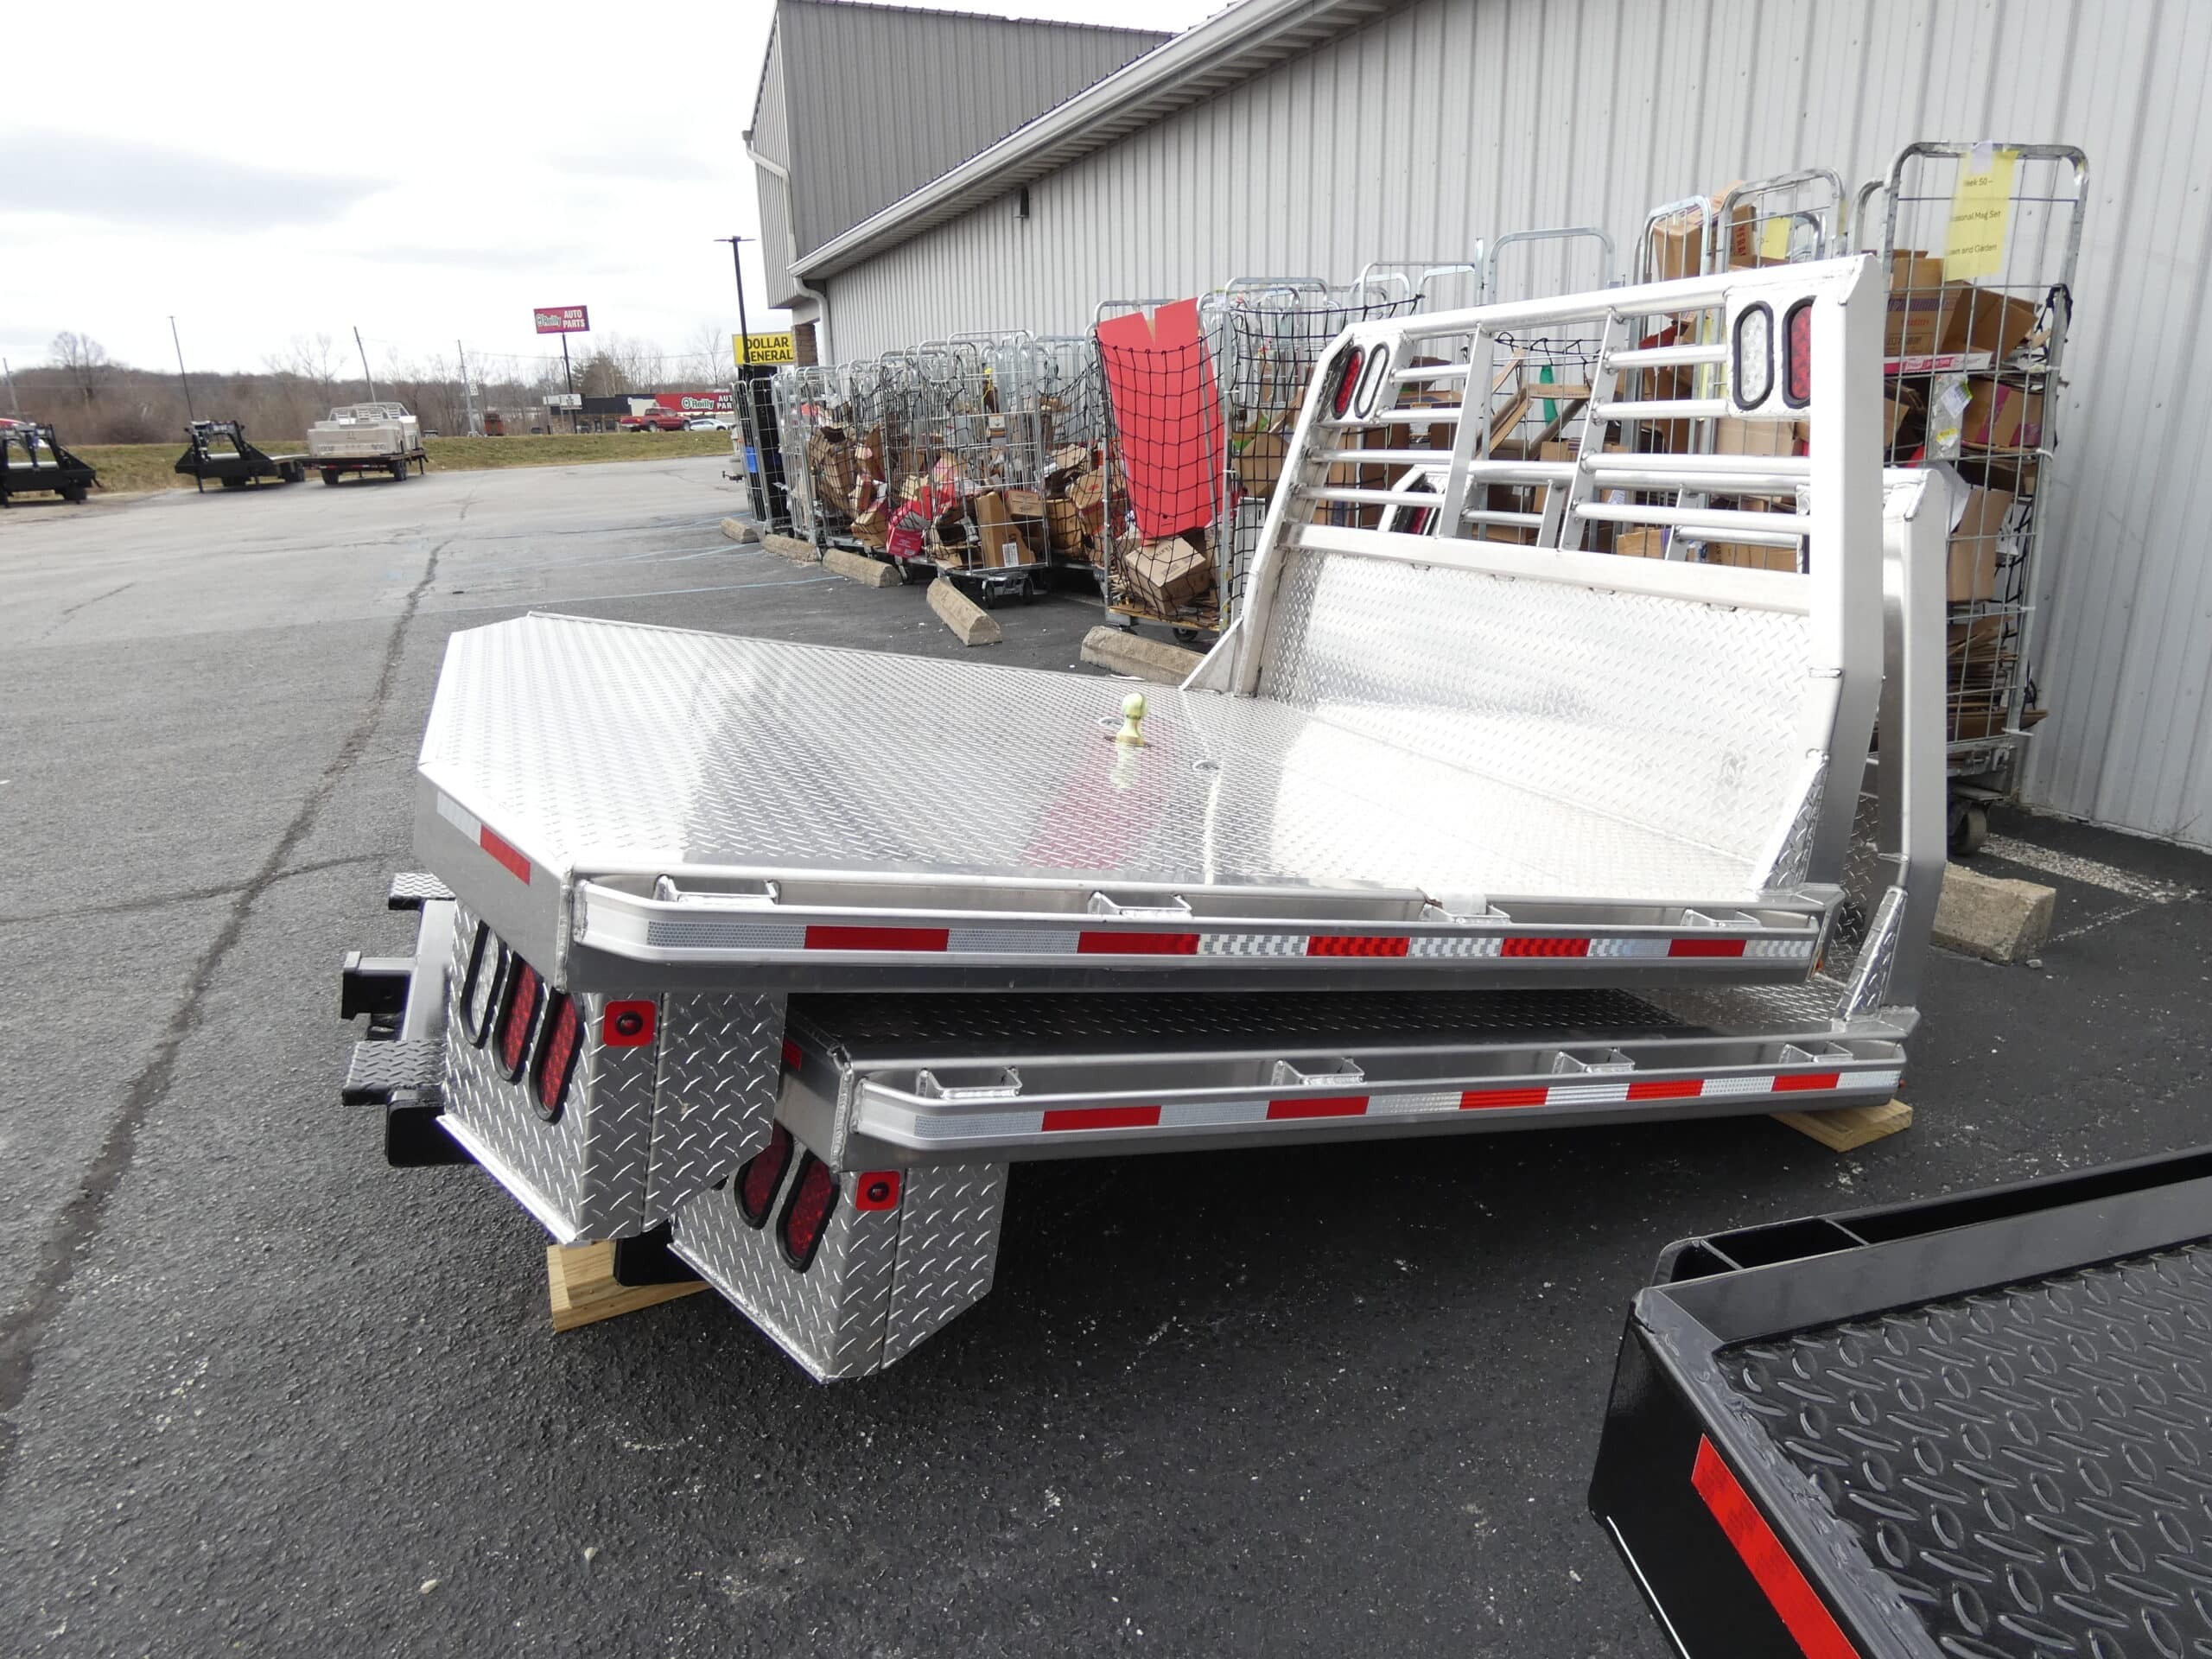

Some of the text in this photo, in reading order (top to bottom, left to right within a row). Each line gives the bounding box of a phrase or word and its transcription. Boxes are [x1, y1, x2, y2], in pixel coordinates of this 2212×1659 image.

[1989, 210, 2001, 219] Set
[1974, 244, 1998, 253] Garden
[563, 309, 582, 319] AUTO
[563, 319, 586, 329] PARTS
[746, 336, 789, 350] DOLLAR
[749, 349, 794, 362] ENERAL
[681, 397, 715, 410] O'Reilly
